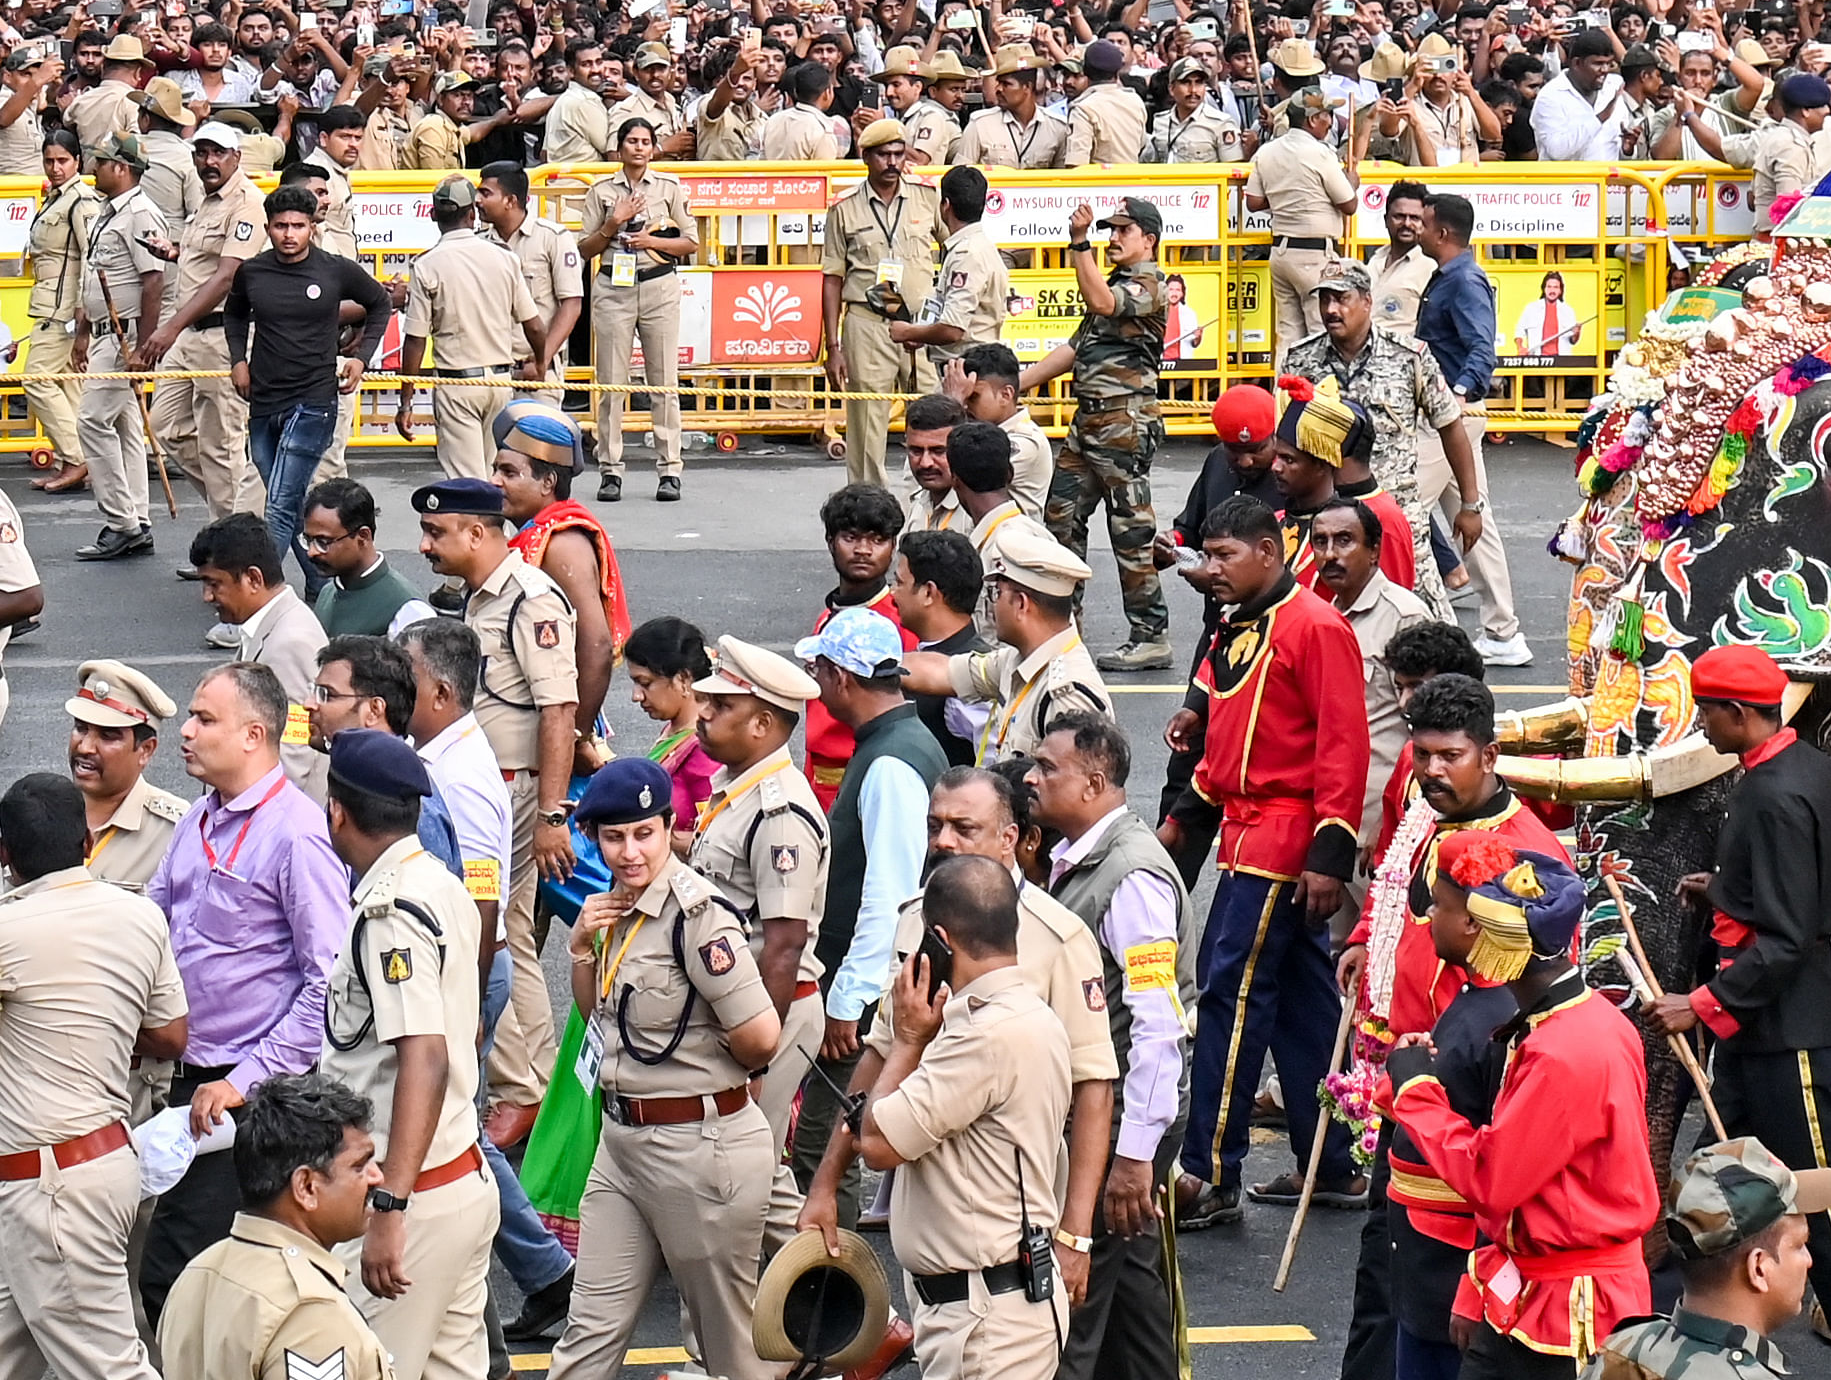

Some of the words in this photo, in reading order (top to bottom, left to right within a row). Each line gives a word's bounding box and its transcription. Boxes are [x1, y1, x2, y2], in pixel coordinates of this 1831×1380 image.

[1012, 195, 1063, 209] MYSURU
[1066, 194, 1091, 208] CITY
[1191, 192, 1211, 209] 112
[1476, 192, 1519, 205] TRAFFIC
[1523, 192, 1563, 205] POLICE
[1573, 190, 1591, 207] 112
[6, 203, 29, 221] 112
[361, 203, 404, 216] POLICE
[1009, 222, 1063, 237] Follow
[1490, 219, 1565, 235] Discipline
[1037, 289, 1061, 305] SK
[1038, 305, 1067, 317] TMT
